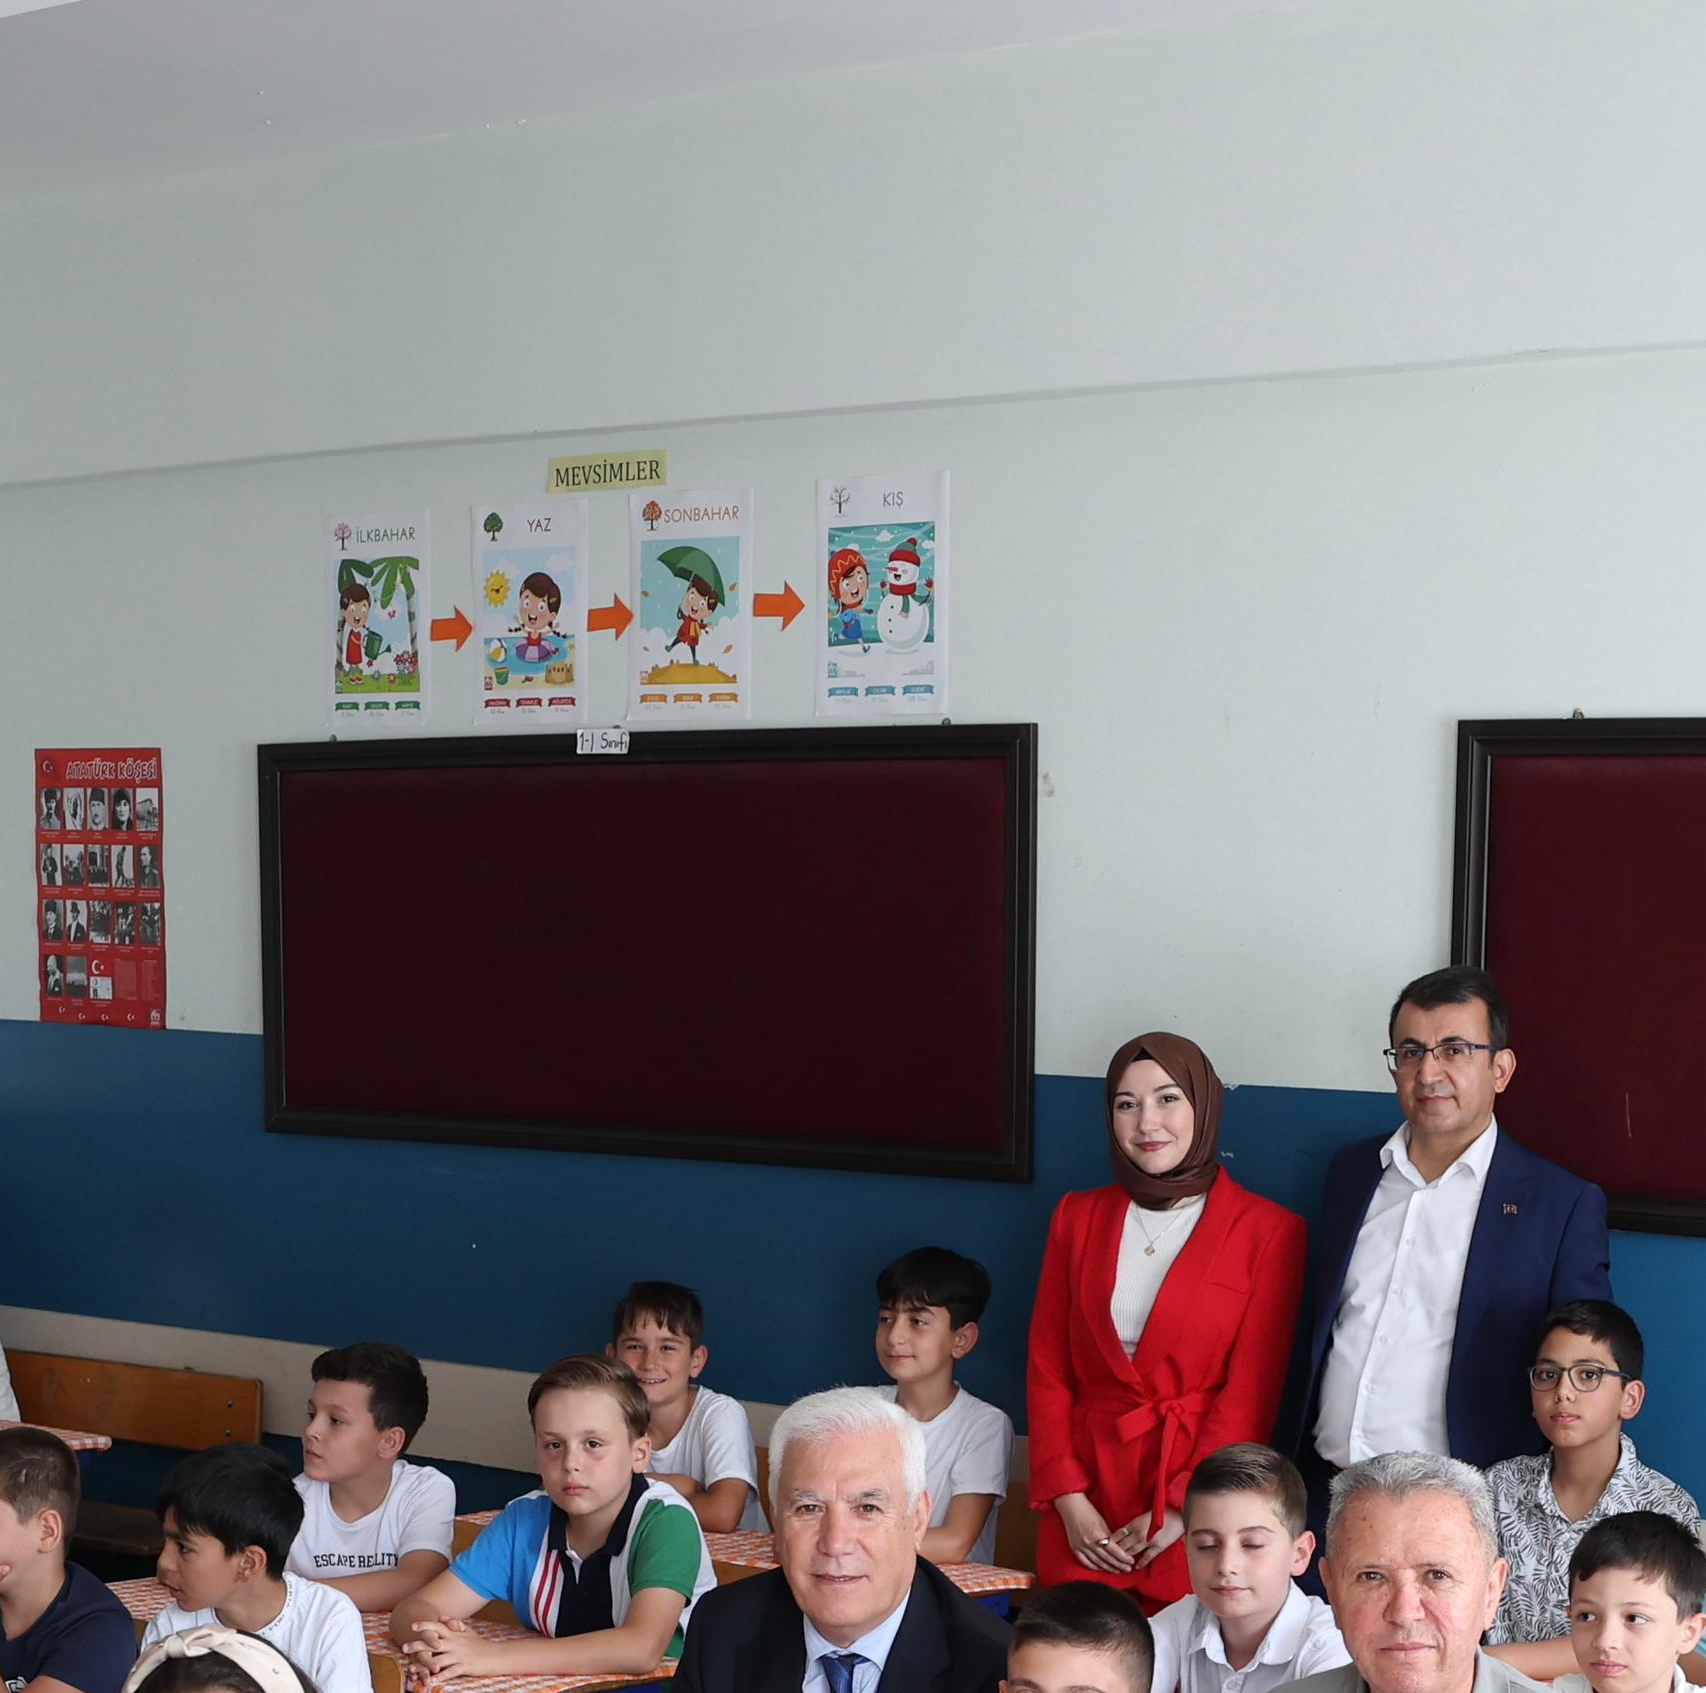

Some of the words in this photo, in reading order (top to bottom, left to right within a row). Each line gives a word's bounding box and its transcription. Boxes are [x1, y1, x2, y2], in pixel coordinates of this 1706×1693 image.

[555, 459, 661, 488] MEVSİMLER
[883, 491, 904, 510] KIŞ
[663, 505, 741, 523] SONBAHAR
[527, 517, 551, 533] YAZ
[356, 526, 415, 543] İLKBAHAR
[66, 757, 115, 780] ATATÜRK
[117, 757, 158, 784] KÖŞESİ
[313, 1552, 356, 1568] ESCAPE
[357, 1552, 400, 1568] RELITY
